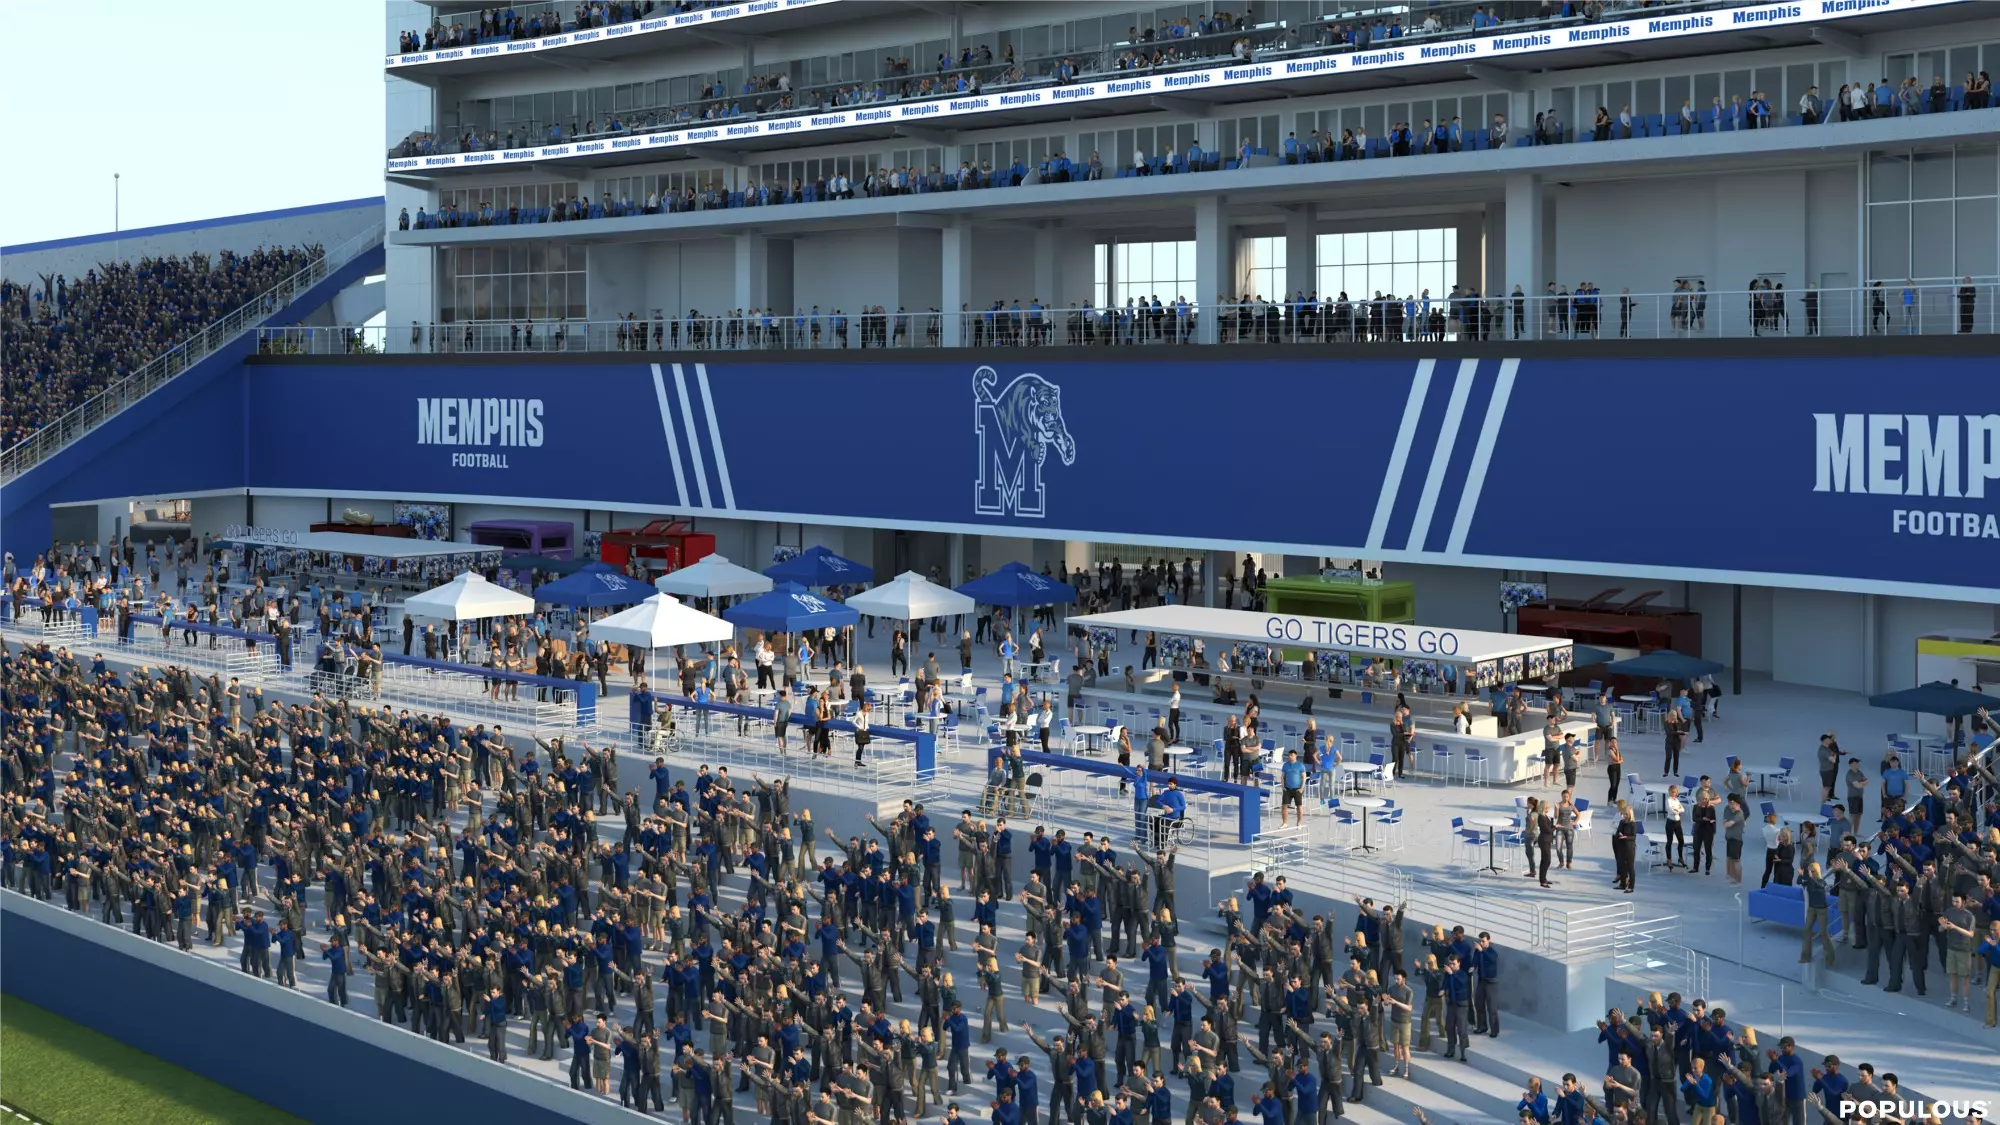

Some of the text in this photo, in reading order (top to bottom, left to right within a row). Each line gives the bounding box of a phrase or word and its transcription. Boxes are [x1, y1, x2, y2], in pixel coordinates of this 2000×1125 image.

[402, 55, 428, 63] Memphis
[436, 50, 463, 59] Memphis
[471, 46, 499, 55] Memphis
[507, 42, 535, 51] Memphis
[543, 37, 567, 46] Memphis
[574, 32, 599, 41] Memphis
[607, 26, 632, 36] Memphis
[640, 20, 667, 30] Memphis
[675, 14, 703, 24] Memphis
[711, 8, 739, 18] Memphis
[748, 1, 778, 12] Memphis
[389, 160, 417, 168] Memphis
[426, 157, 455, 165] Memphis
[464, 154, 494, 162] Memphis
[503, 151, 534, 159] Memphis
[542, 147, 568, 156] Memphis
[577, 143, 604, 152] Memphis
[612, 139, 641, 148] Memphis
[649, 134, 678, 144] Memphis
[688, 130, 718, 140] Memphis
[727, 125, 759, 135] Memphis
[768, 120, 801, 131] Memphis
[811, 115, 845, 126] Memphis
[856, 110, 891, 121] Memphis
[902, 104, 939, 116] Memphis
[950, 99, 988, 110] Memphis
[1000, 93, 1040, 105] Memphis
[1053, 86, 1094, 99] Memphis
[1107, 80, 1151, 93] Memphis
[1164, 73, 1210, 87] Memphis
[1224, 66, 1272, 80] Memphis
[1287, 59, 1336, 73] Memphis
[1352, 51, 1404, 66] Memphis
[1421, 43, 1475, 58] Memphis
[1493, 34, 1551, 50] Memphis
[1569, 25, 1629, 41] Memphis
[1649, 16, 1713, 33] Memphis
[1733, 6, 1800, 23] Memphis
[417, 397, 544, 447] MEMPHIS
[452, 453, 509, 468] FOOTBALL
[1812, 413, 2000, 498] MEMP
[282, 529, 298, 544] GO
[1893, 510, 2000, 539] FOOTBA
[1266, 617, 1459, 656] GO TIGERS GO
